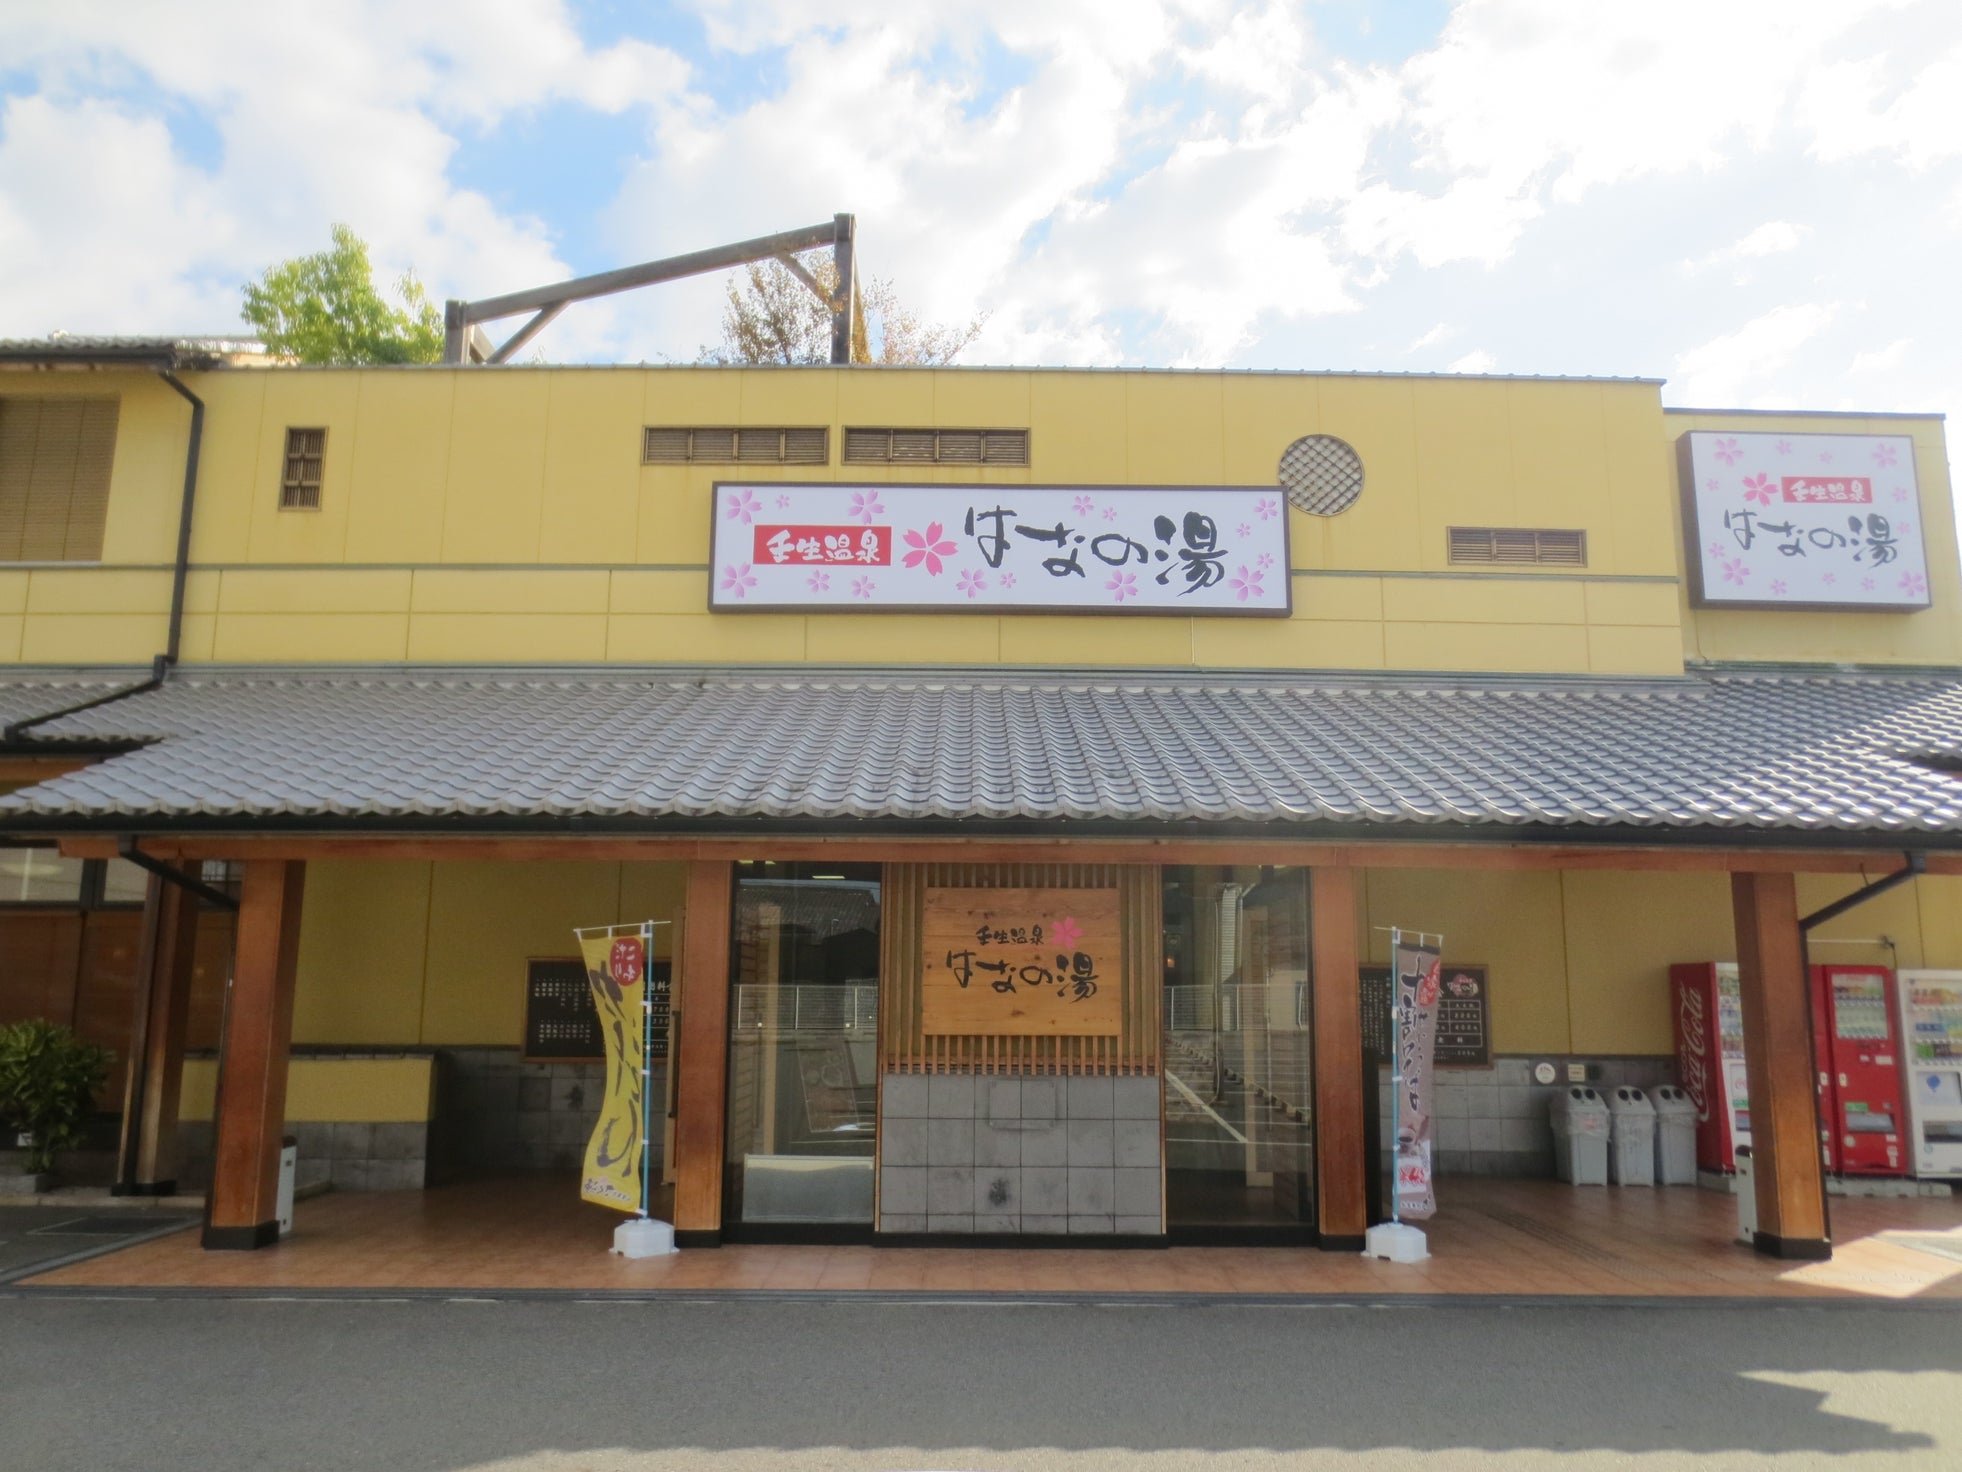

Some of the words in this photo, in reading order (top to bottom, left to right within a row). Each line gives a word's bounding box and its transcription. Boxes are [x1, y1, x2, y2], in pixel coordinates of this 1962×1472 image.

[766, 529, 880, 563] 壬生温泉
[965, 505, 1229, 597] はなの湯
[1724, 508, 1898, 568] はなの湯
[975, 924, 1044, 946] 壬生温泉
[946, 949, 1099, 1004] はなの湯
